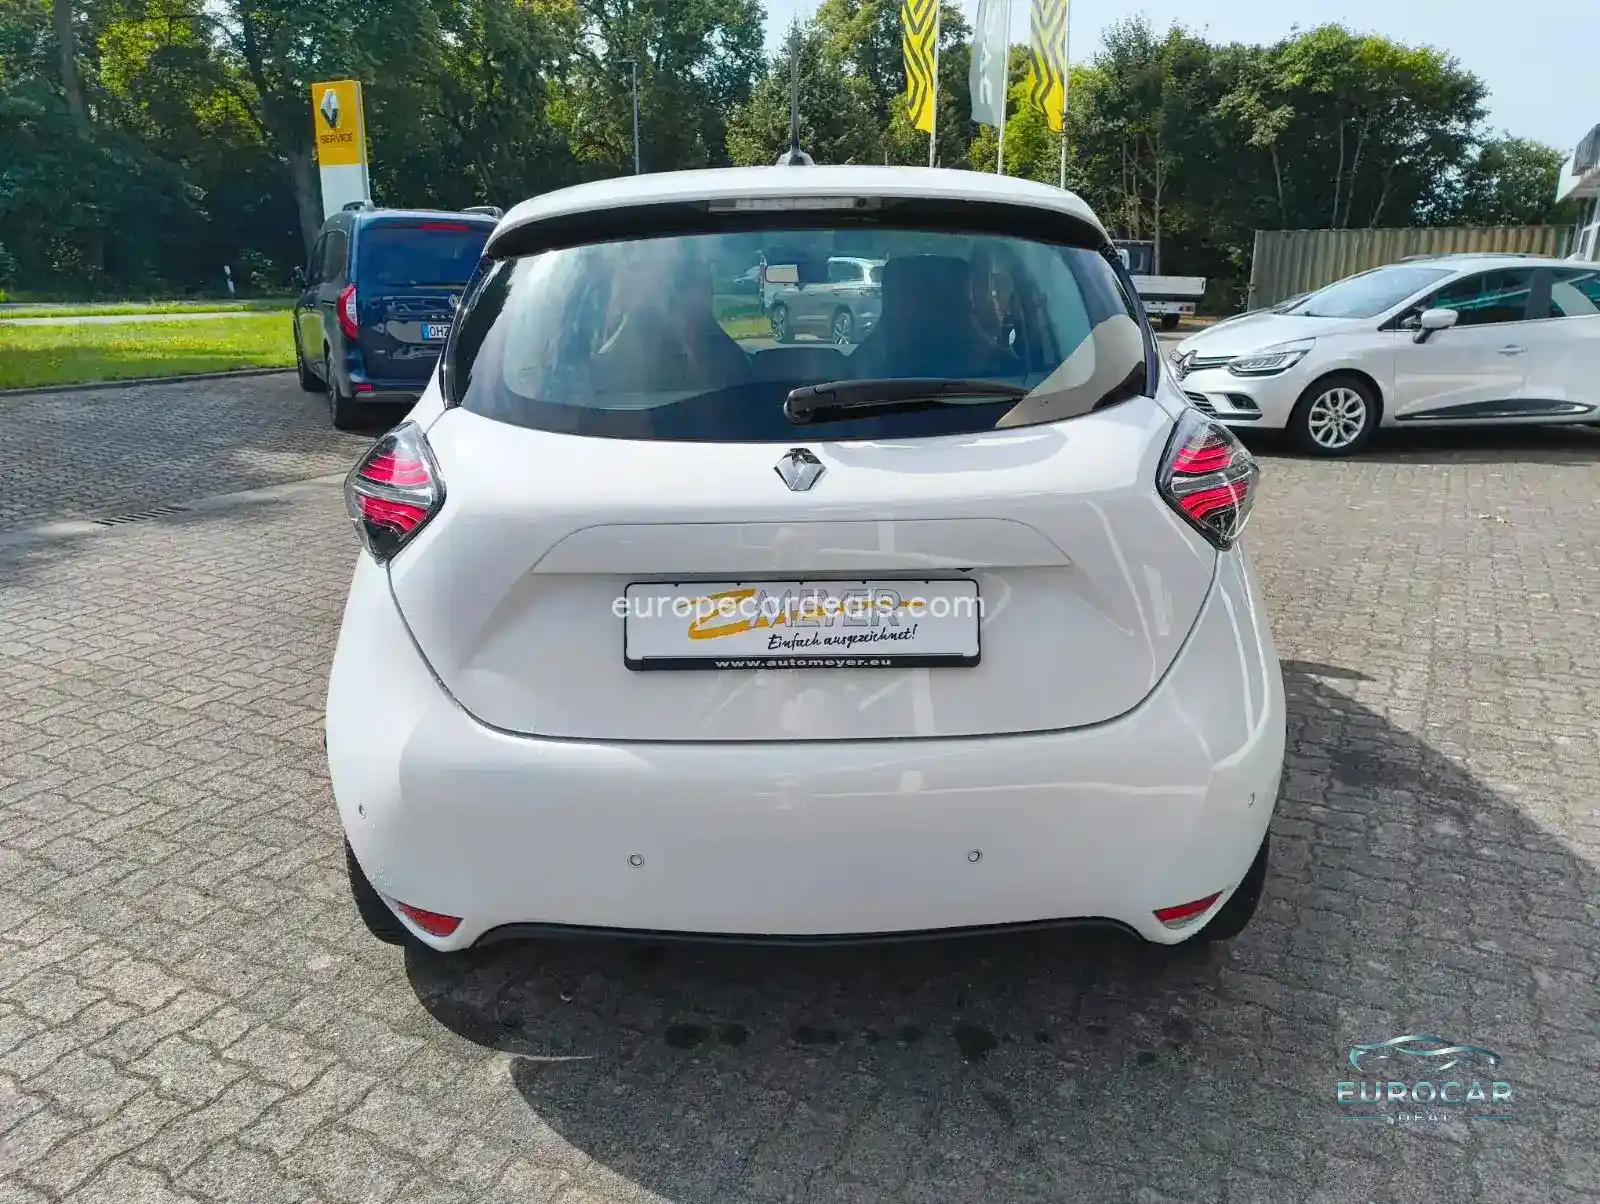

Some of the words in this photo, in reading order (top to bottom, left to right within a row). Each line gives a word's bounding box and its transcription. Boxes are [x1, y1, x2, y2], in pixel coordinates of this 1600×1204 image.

[320, 133, 353, 144] SERVICE
[750, 588, 902, 628] MEYER
[768, 630, 821, 651] Einfach
[824, 624, 918, 648] ausgezeichnet!
[715, 658, 892, 668] www.automeyer.eu
